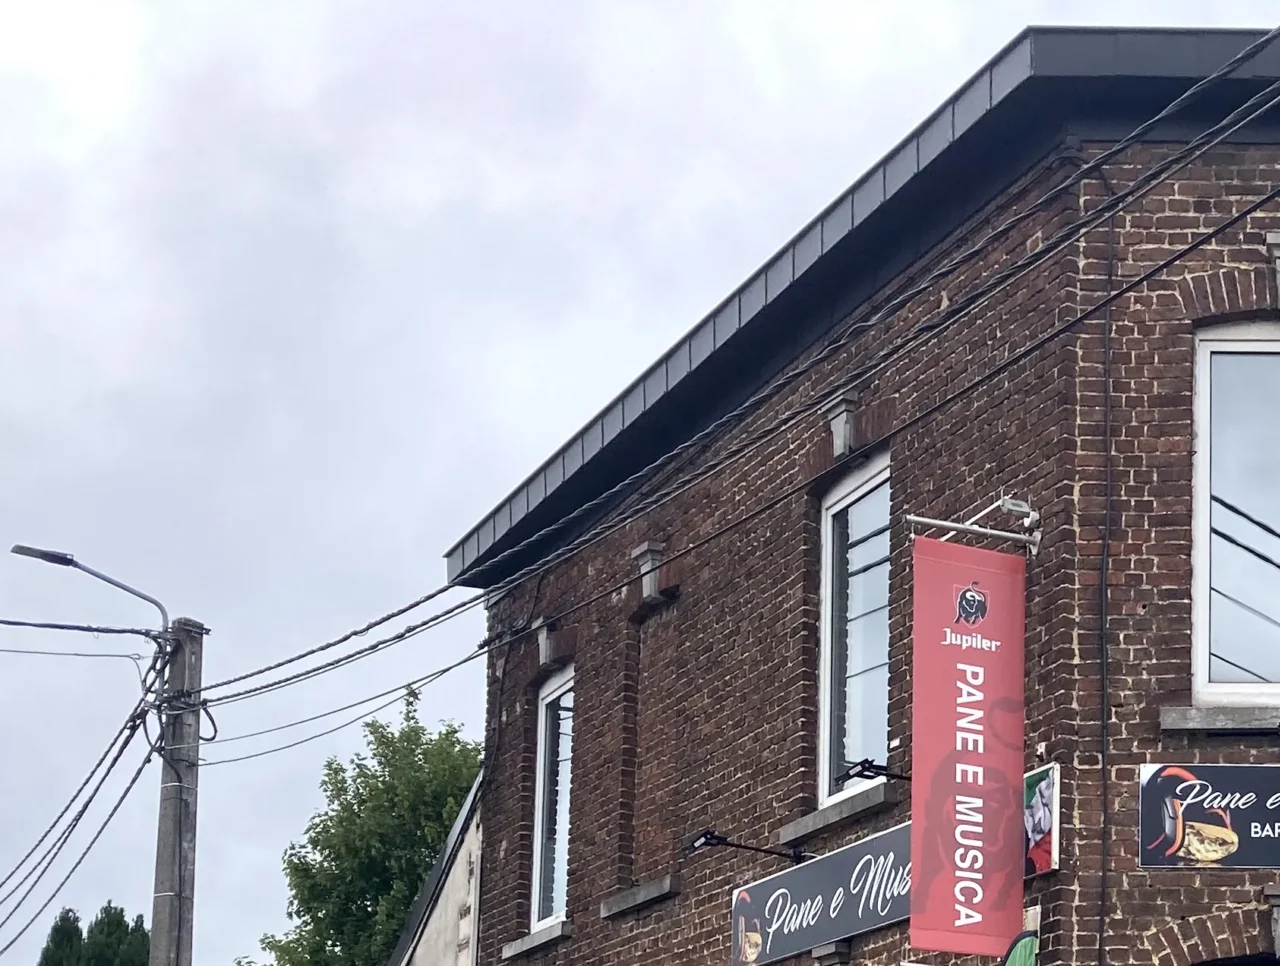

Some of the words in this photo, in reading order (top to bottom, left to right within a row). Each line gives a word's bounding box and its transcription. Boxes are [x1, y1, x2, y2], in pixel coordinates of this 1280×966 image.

[941, 628, 1001, 652] Jupiler
[956, 663, 985, 754] PANE
[955, 766, 984, 787] E
[1175, 779, 1257, 814] Pane
[953, 795, 984, 929] MUSICA
[765, 888, 823, 954] Pane
[830, 886, 845, 919] e
[850, 851, 911, 922] Mus
